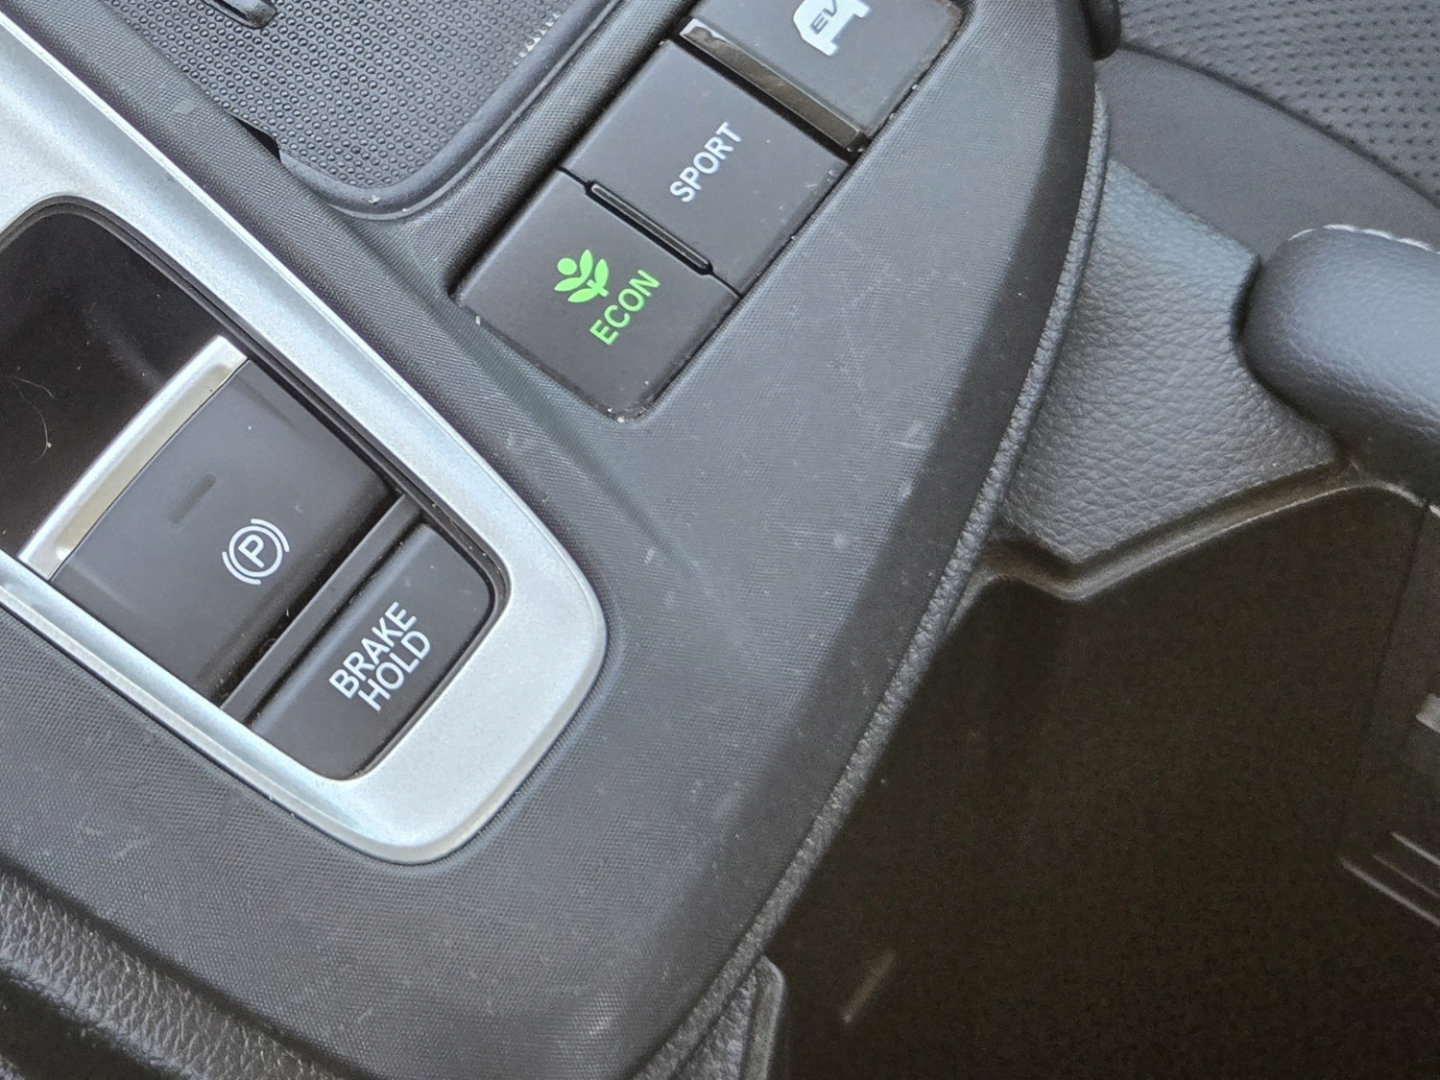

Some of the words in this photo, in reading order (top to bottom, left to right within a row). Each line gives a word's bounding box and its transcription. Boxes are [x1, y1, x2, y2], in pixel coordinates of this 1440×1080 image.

[669, 121, 743, 203] SPORT
[589, 269, 661, 346] ECON
[329, 601, 417, 700] BRAKE
[357, 630, 431, 712] HOLD
